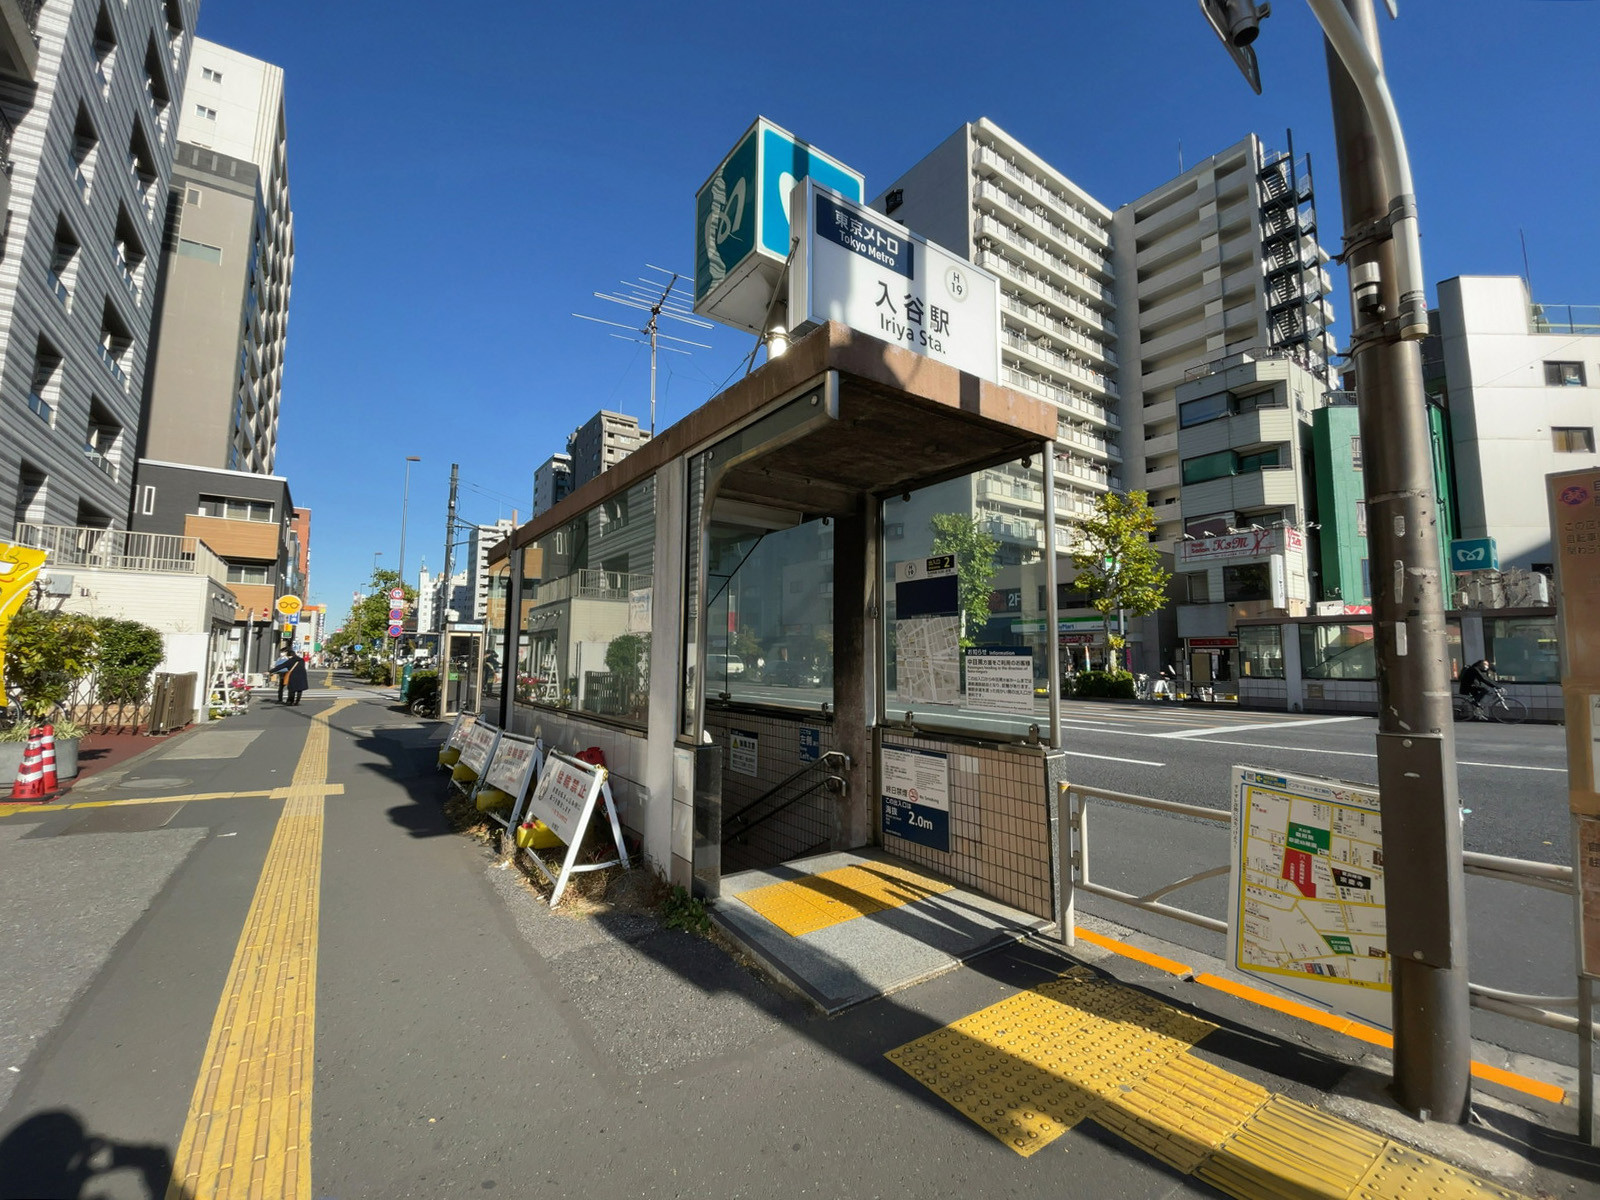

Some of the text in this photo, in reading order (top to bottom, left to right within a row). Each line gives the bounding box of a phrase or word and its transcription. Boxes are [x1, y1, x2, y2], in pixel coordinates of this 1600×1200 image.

[834, 209, 899, 255] 東京メトロ
[839, 229, 895, 266] Tokyo Metro
[953, 272, 960, 283] H
[951, 282, 963, 295] 19
[875, 280, 950, 337] 入谷駅
[880, 312, 946, 354] Iriya Sta.
[943, 556, 951, 568] 2
[1008, 592, 1021, 607] 2F
[908, 811, 933, 830] 2.0m
